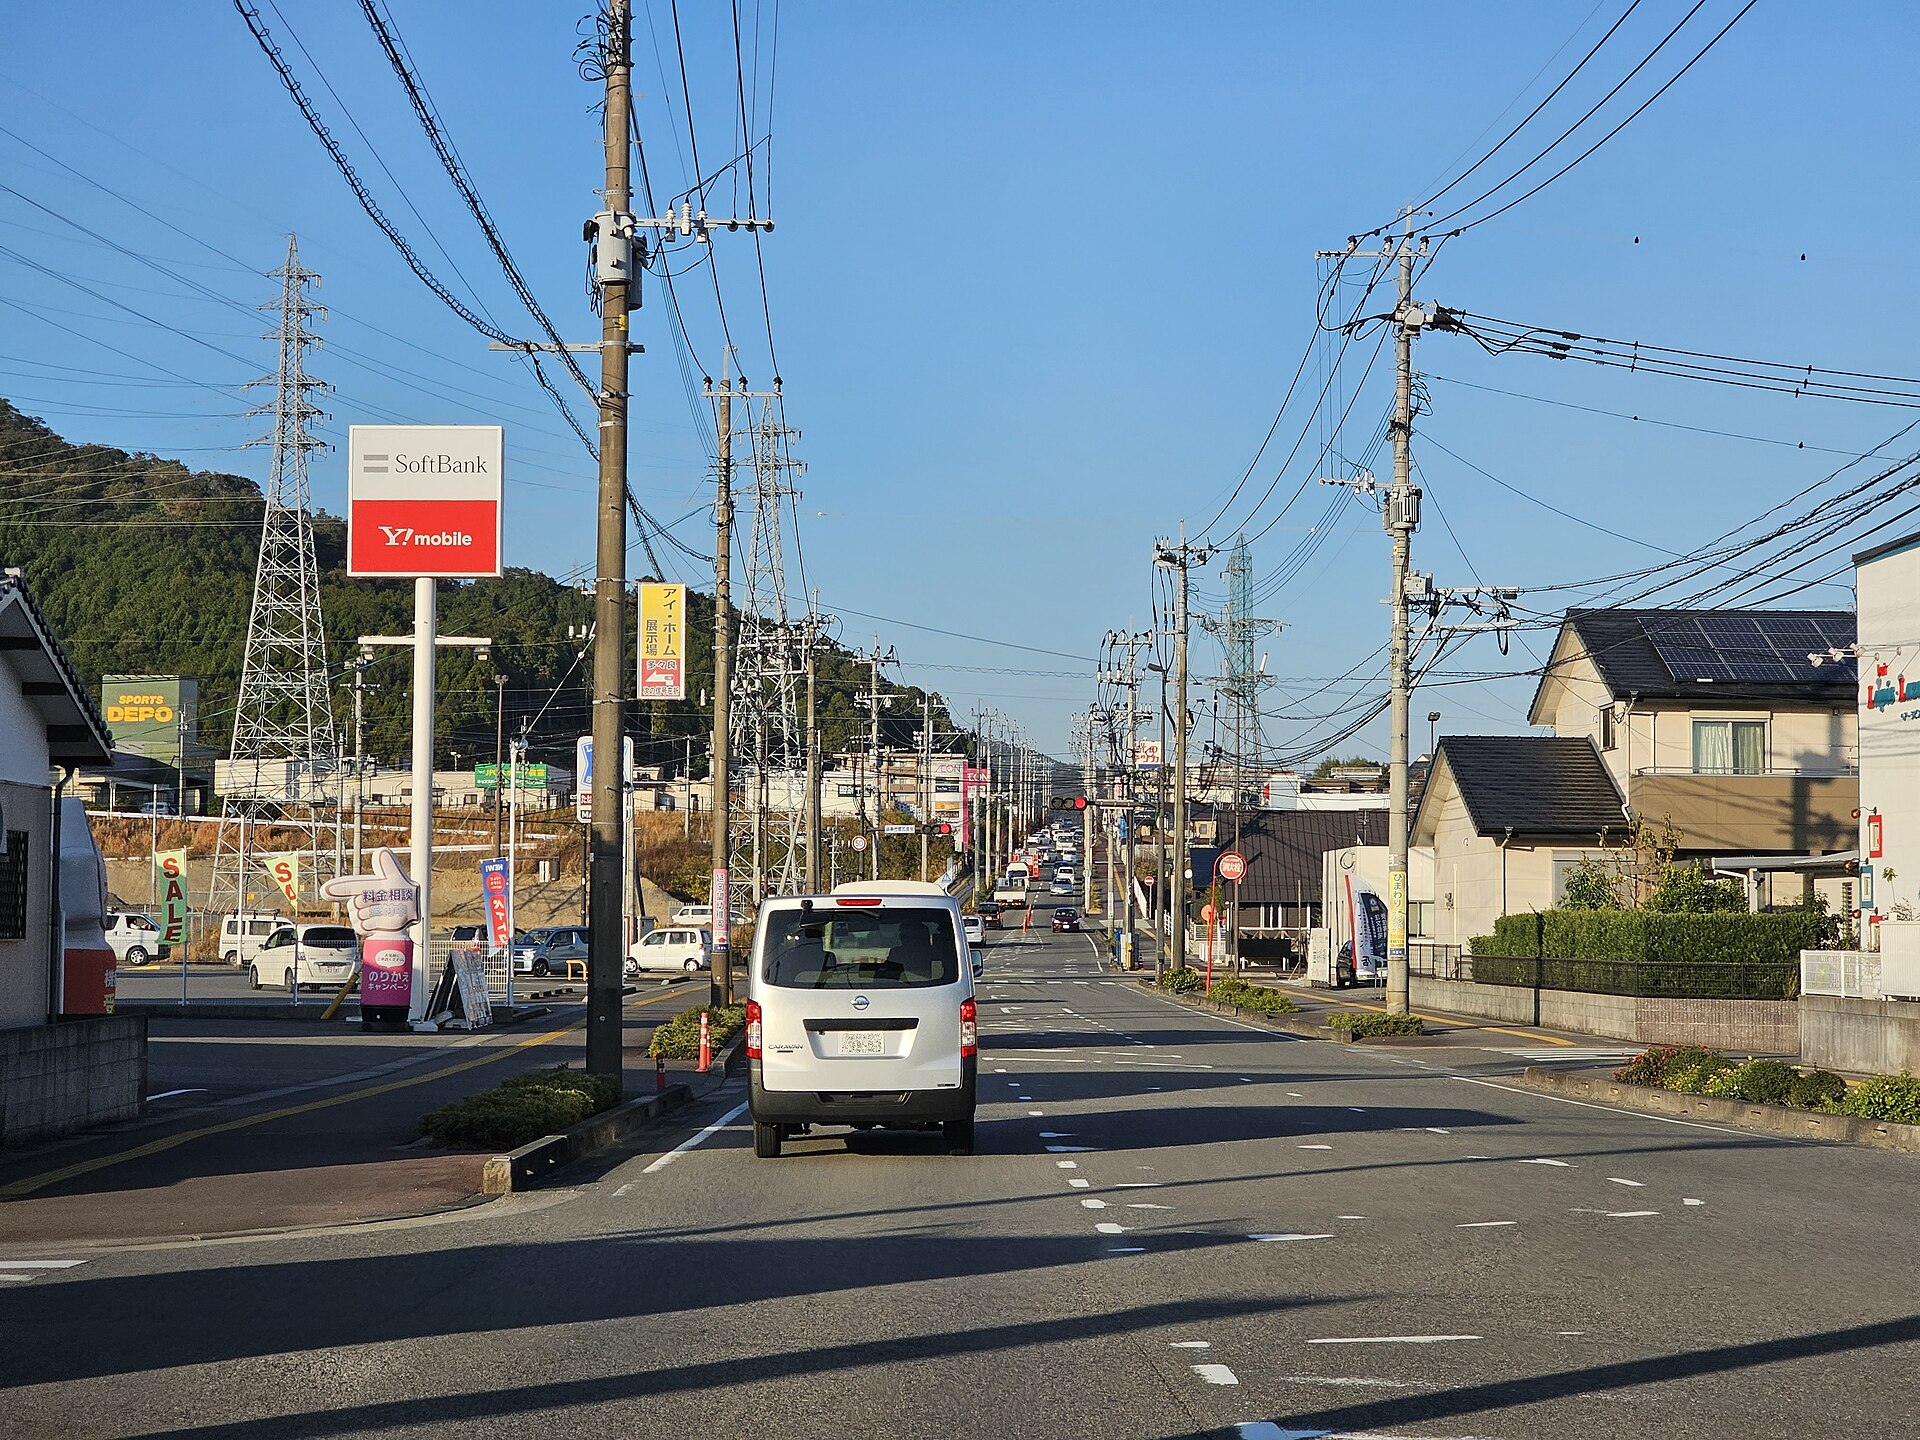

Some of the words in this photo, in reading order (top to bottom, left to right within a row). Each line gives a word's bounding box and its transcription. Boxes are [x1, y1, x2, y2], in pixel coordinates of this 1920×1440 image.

[395, 454, 488, 474] SoftBank
[378, 526, 472, 547] Y!mobile
[663, 588, 677, 656] アイ・ホーム
[645, 619, 658, 656] 展示場
[646, 660, 677, 670] 多々良
[118, 694, 165, 705] SPORTS
[107, 706, 174, 723] DEPO
[1222, 862, 1242, 873] 消火栓
[362, 888, 413, 902] 料金相談
[1393, 873, 1403, 908] ひまわり
[162, 857, 183, 943] SALE
[369, 971, 409, 983] のりかえ
[368, 983, 409, 991] キャンペーン
